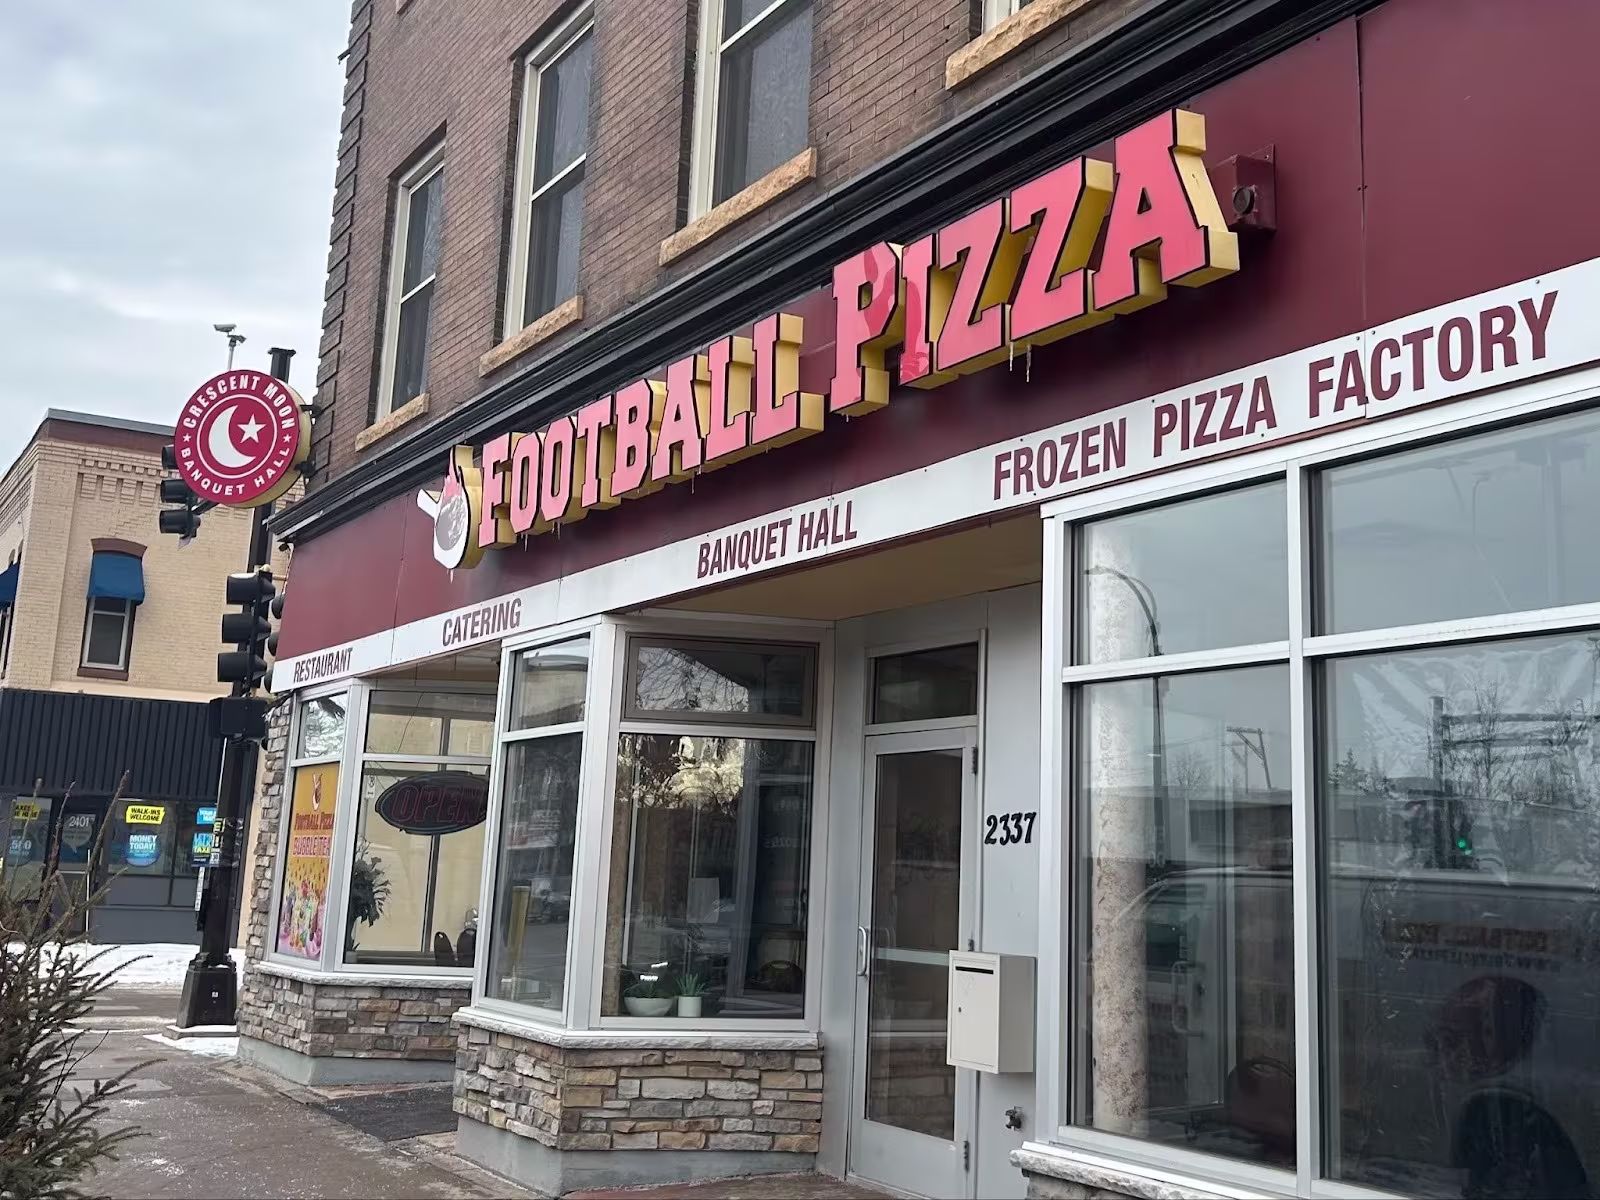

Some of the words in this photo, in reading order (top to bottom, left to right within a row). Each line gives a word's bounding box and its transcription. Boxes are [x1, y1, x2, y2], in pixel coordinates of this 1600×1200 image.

[477, 313, 812, 549] FOOTBALL
[829, 108, 1216, 415] PIZZA
[183, 374, 260, 429] CRESCENT
[263, 382, 296, 430] MOON
[993, 417, 1127, 500] FROZEN
[1153, 375, 1277, 458] PIZZA
[1308, 290, 1559, 419] FACTORY
[181, 447, 245, 496] BANQUET
[254, 447, 291, 488] HALL
[696, 517, 795, 579] BANQUET
[798, 500, 859, 553] HALL
[441, 598, 522, 648] CATERING
[293, 647, 354, 683] RESTAURANT
[69, 816, 90, 827] 2401
[130, 813, 161, 821] WELCOME
[391, 783, 486, 823] OPEN
[130, 834, 157, 842] MONEY
[130, 842, 156, 850] TODAY!
[984, 811, 1037, 846] 2337
